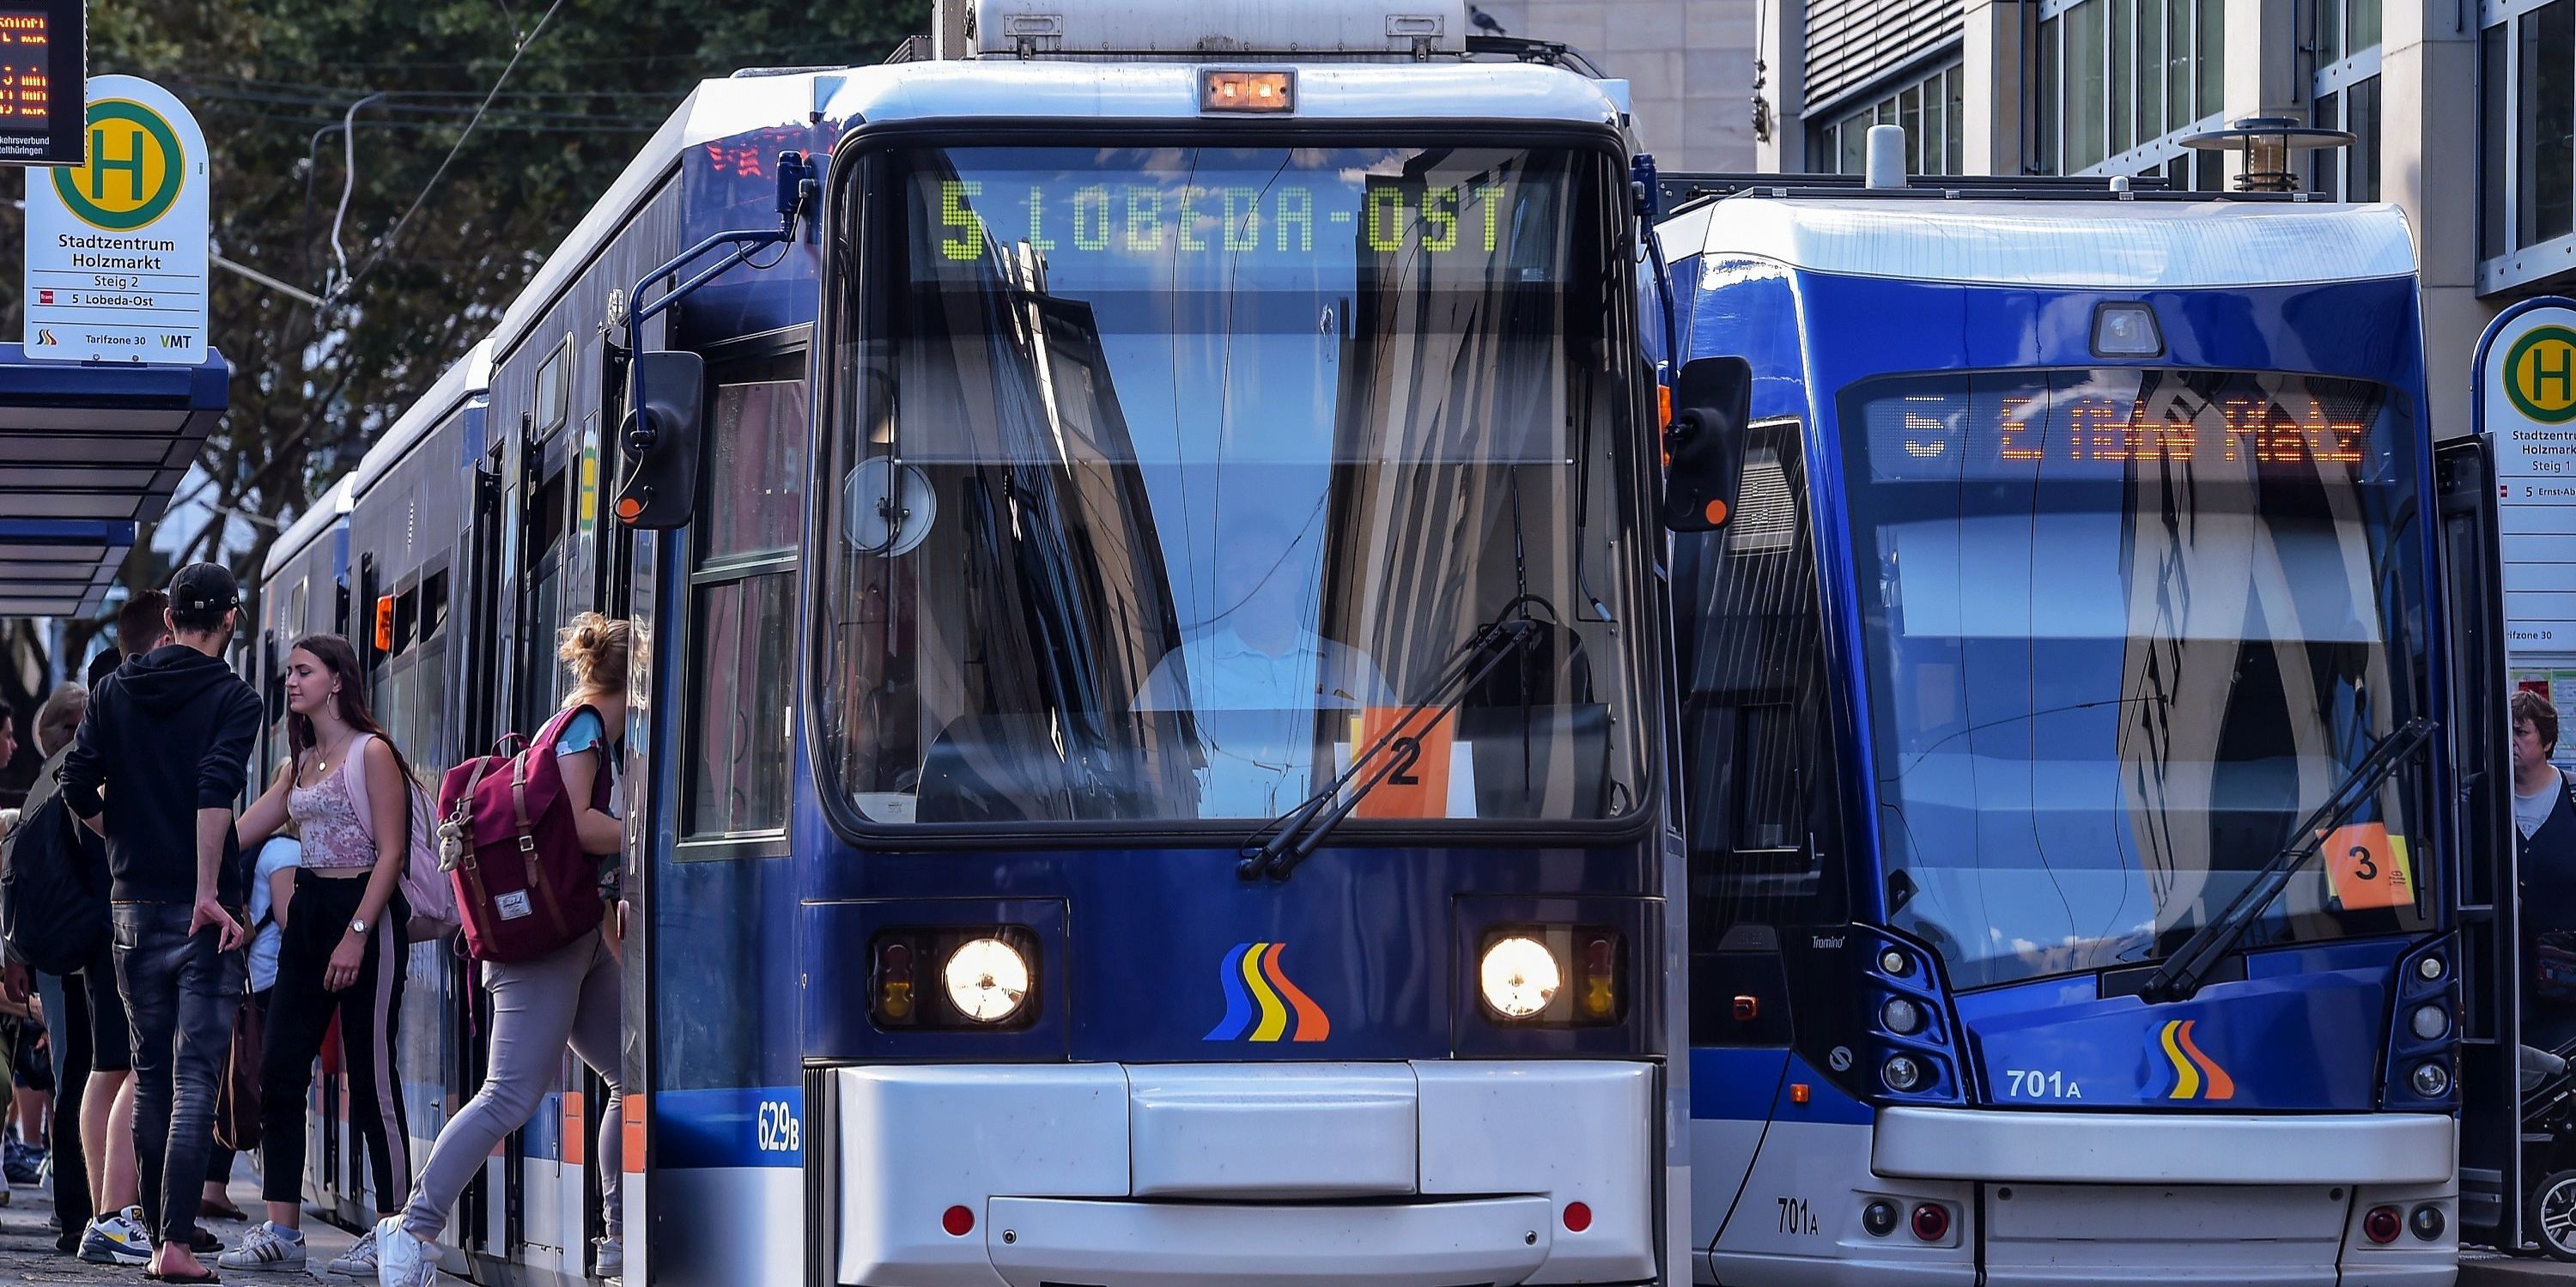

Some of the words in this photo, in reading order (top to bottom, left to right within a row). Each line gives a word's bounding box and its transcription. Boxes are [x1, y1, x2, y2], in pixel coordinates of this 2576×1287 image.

[942, 180, 983, 260] 5
[1030, 186, 1504, 252] LOBEDA-OST
[58, 234, 175, 252] Stadtzentrum
[72, 253, 161, 270] Holzmarkt
[94, 275, 127, 289] Steig
[131, 276, 138, 288] 2
[72, 294, 79, 304] 5
[86, 294, 154, 307] Lobeda-Ost
[86, 335, 131, 345] Tarifzone
[134, 337, 146, 345] 30
[161, 335, 191, 349] VMT
[2522, 444, 2576, 454] Holzmark
[2533, 460, 2561, 473] Steig
[2567, 461, 2570, 470] 1
[2525, 487, 2533, 497] 5
[2542, 631, 2552, 640] 30
[1388, 737, 1421, 786] 2
[2349, 846, 2378, 881] 3
[2007, 1070, 2081, 1099] 701A
[758, 1101, 799, 1151] 629B
[1777, 1197, 1819, 1235] 701A
